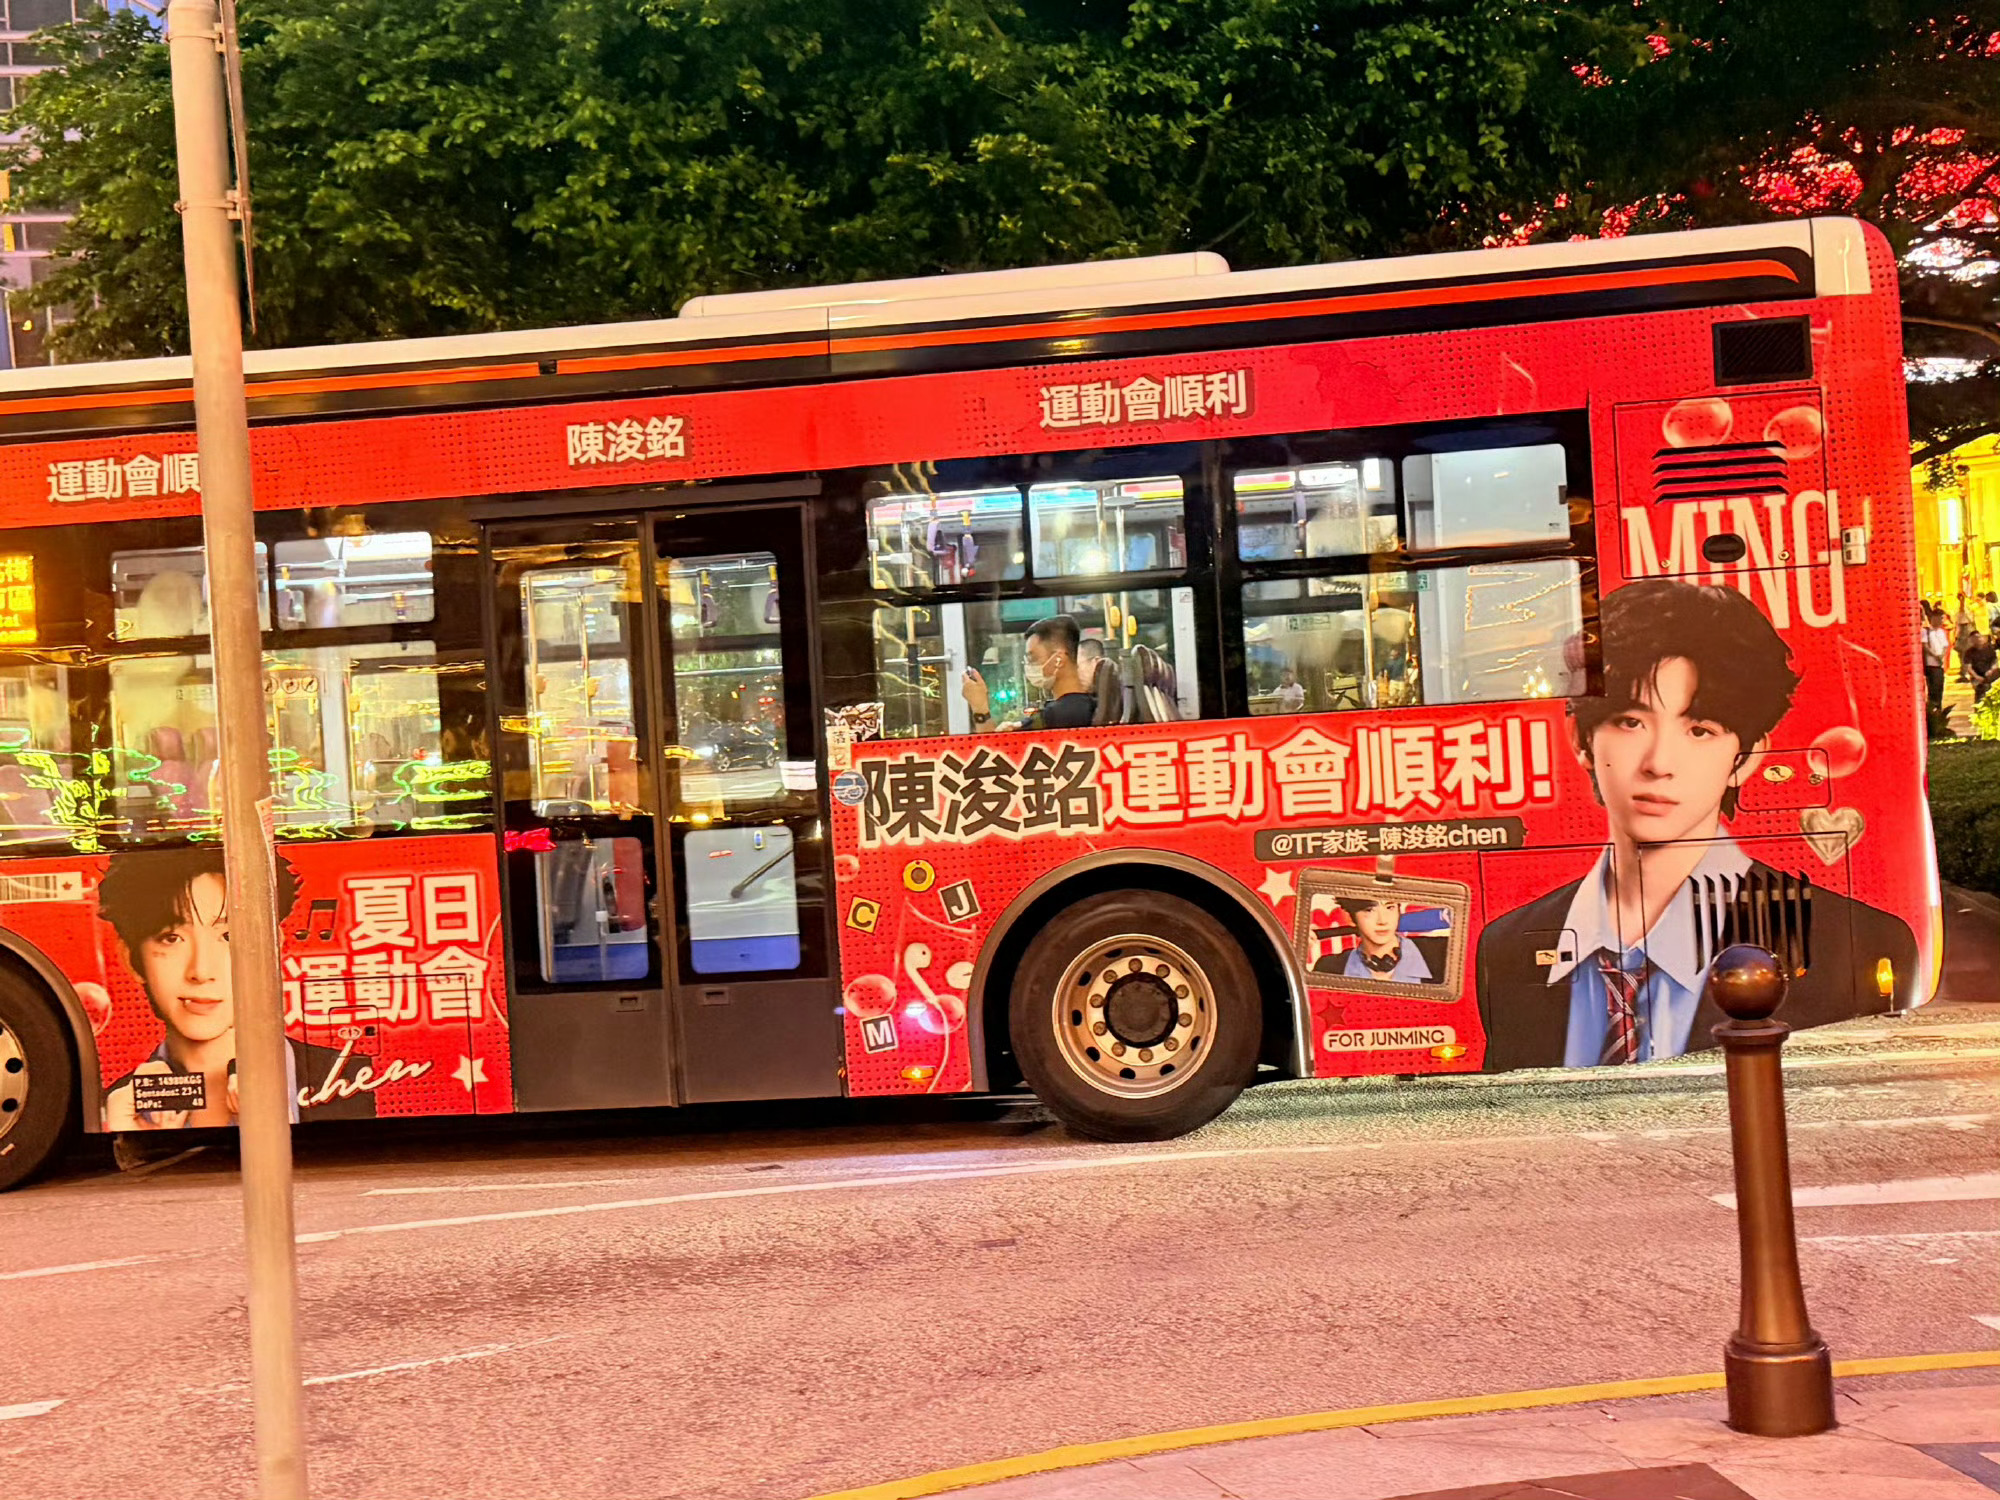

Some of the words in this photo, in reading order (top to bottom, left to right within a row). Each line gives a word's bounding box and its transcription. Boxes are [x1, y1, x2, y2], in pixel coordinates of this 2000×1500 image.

[1038, 369, 1247, 429] 運動會順利
[566, 415, 685, 466] 陳浚銘
[46, 452, 201, 503] 運動會順
[1621, 489, 1847, 629] MING
[1271, 823, 1508, 857] @TF家族-陳浚銘chen
[346, 874, 480, 950] 夏日
[851, 901, 876, 928] C
[950, 885, 971, 917] J
[283, 945, 489, 1026] 運動會
[865, 1020, 893, 1048] M
[1328, 1032, 1365, 1048] FOR
[1370, 1029, 1445, 1046] JUNMING
[297, 1039, 432, 1107] chen
